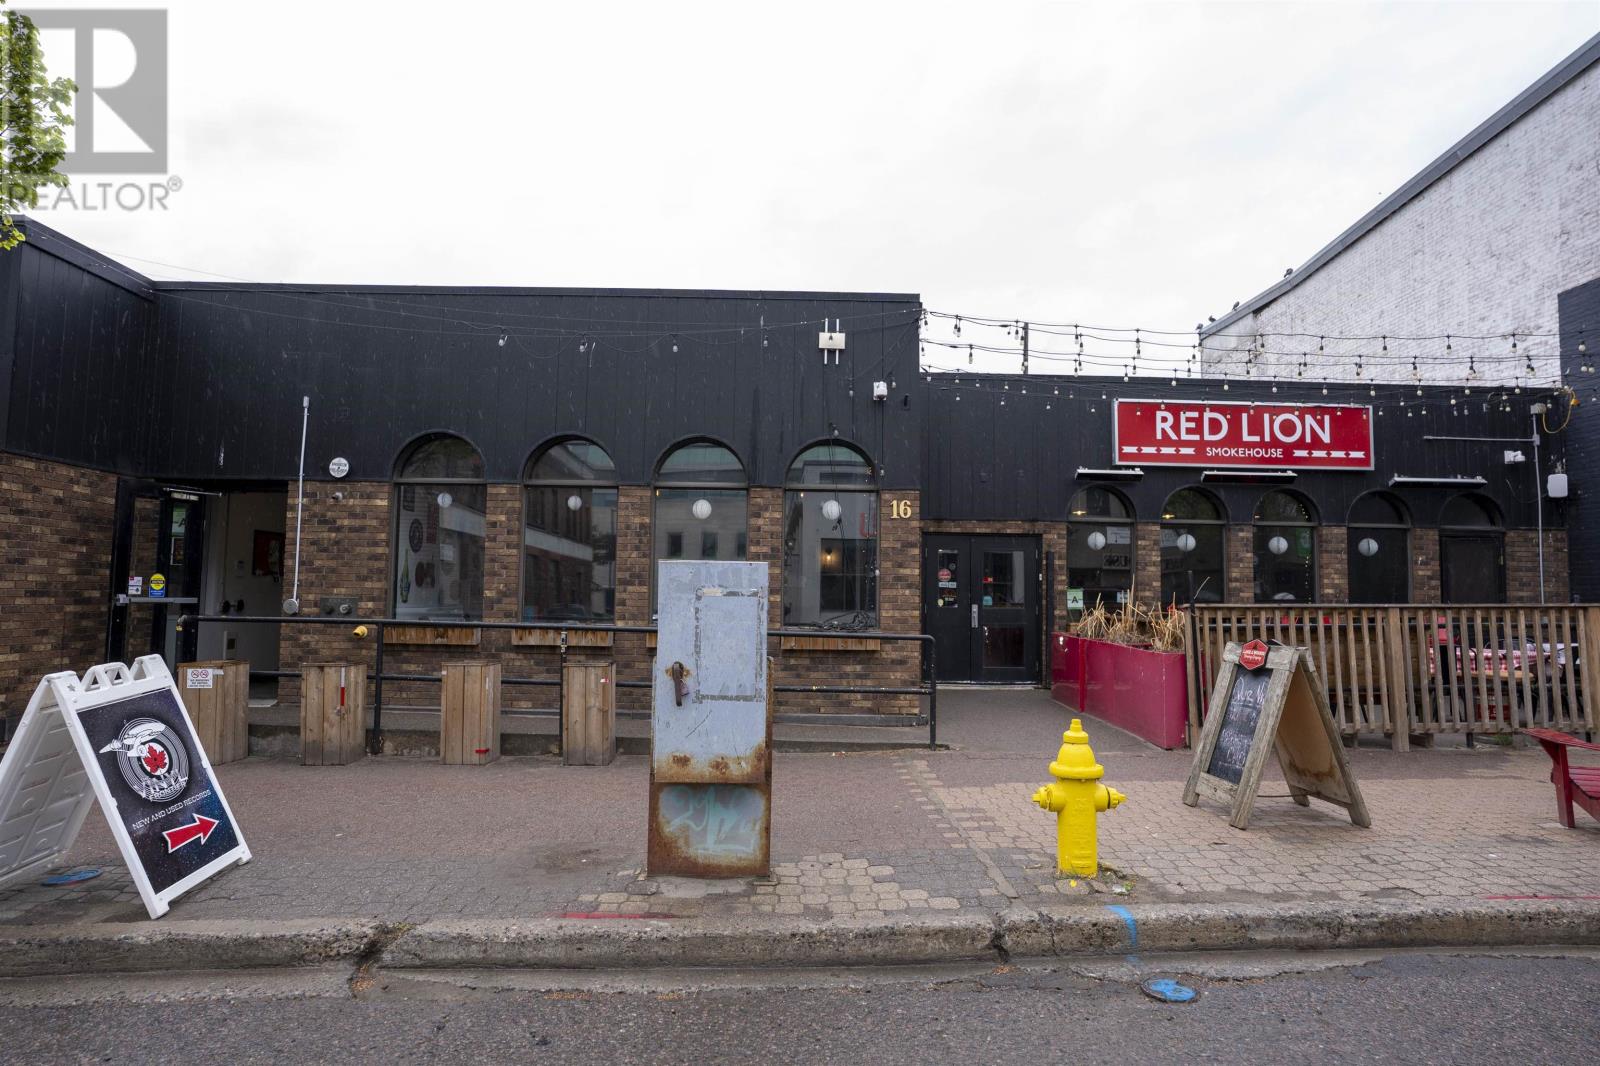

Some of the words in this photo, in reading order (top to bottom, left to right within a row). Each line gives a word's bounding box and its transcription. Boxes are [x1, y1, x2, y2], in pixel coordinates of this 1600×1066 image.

[1155, 410, 1229, 441] RED
[1241, 412, 1331, 444] LION
[1206, 447, 1283, 458] SMOKEHOUSE
[890, 499, 912, 519] 16
[132, 816, 150, 830] NEW
[151, 810, 166, 822] AND
[165, 802, 184, 815] USED
[183, 789, 212, 806] RECORDS
